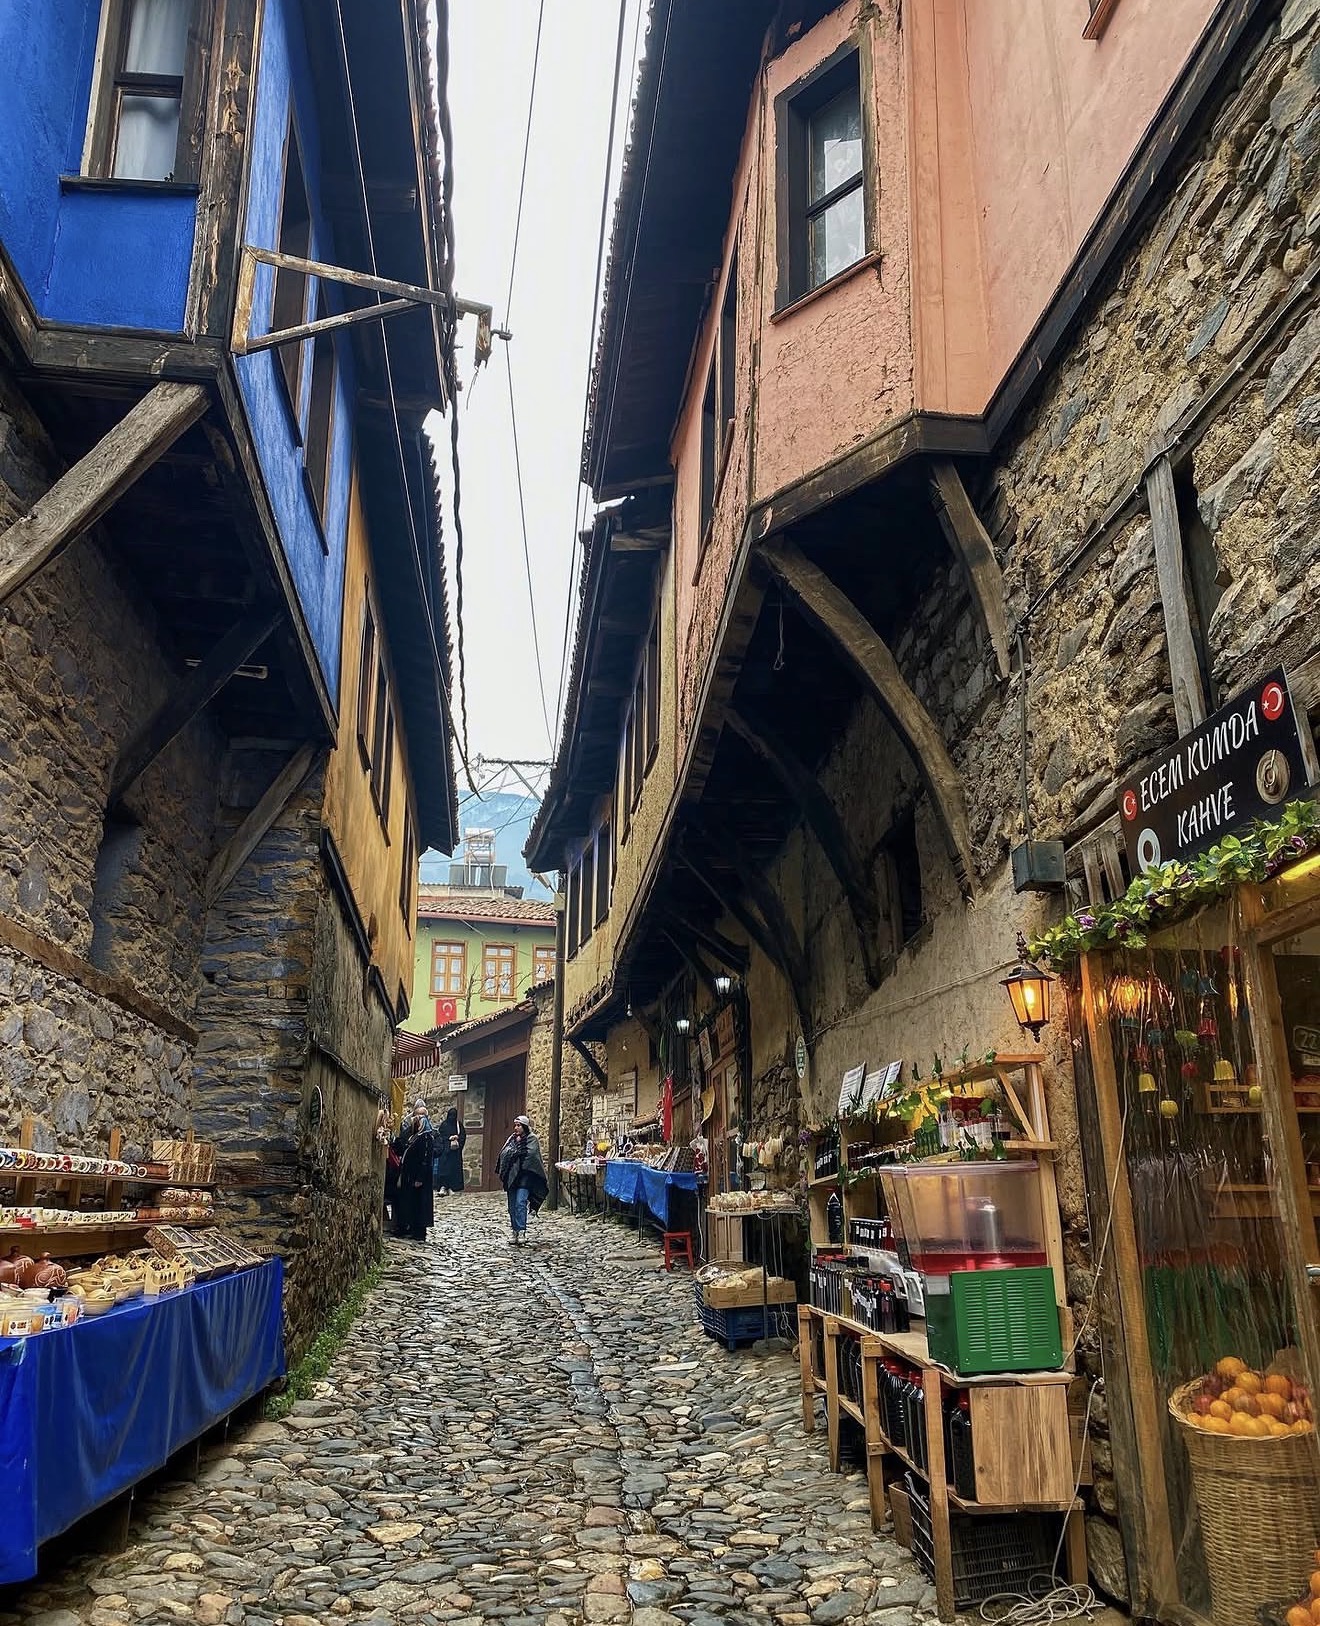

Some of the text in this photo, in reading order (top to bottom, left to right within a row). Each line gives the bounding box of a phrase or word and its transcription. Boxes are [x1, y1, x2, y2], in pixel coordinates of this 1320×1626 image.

[1140, 701, 1259, 812] ECEM KUMDA
[1178, 782, 1235, 847] KAHVE
